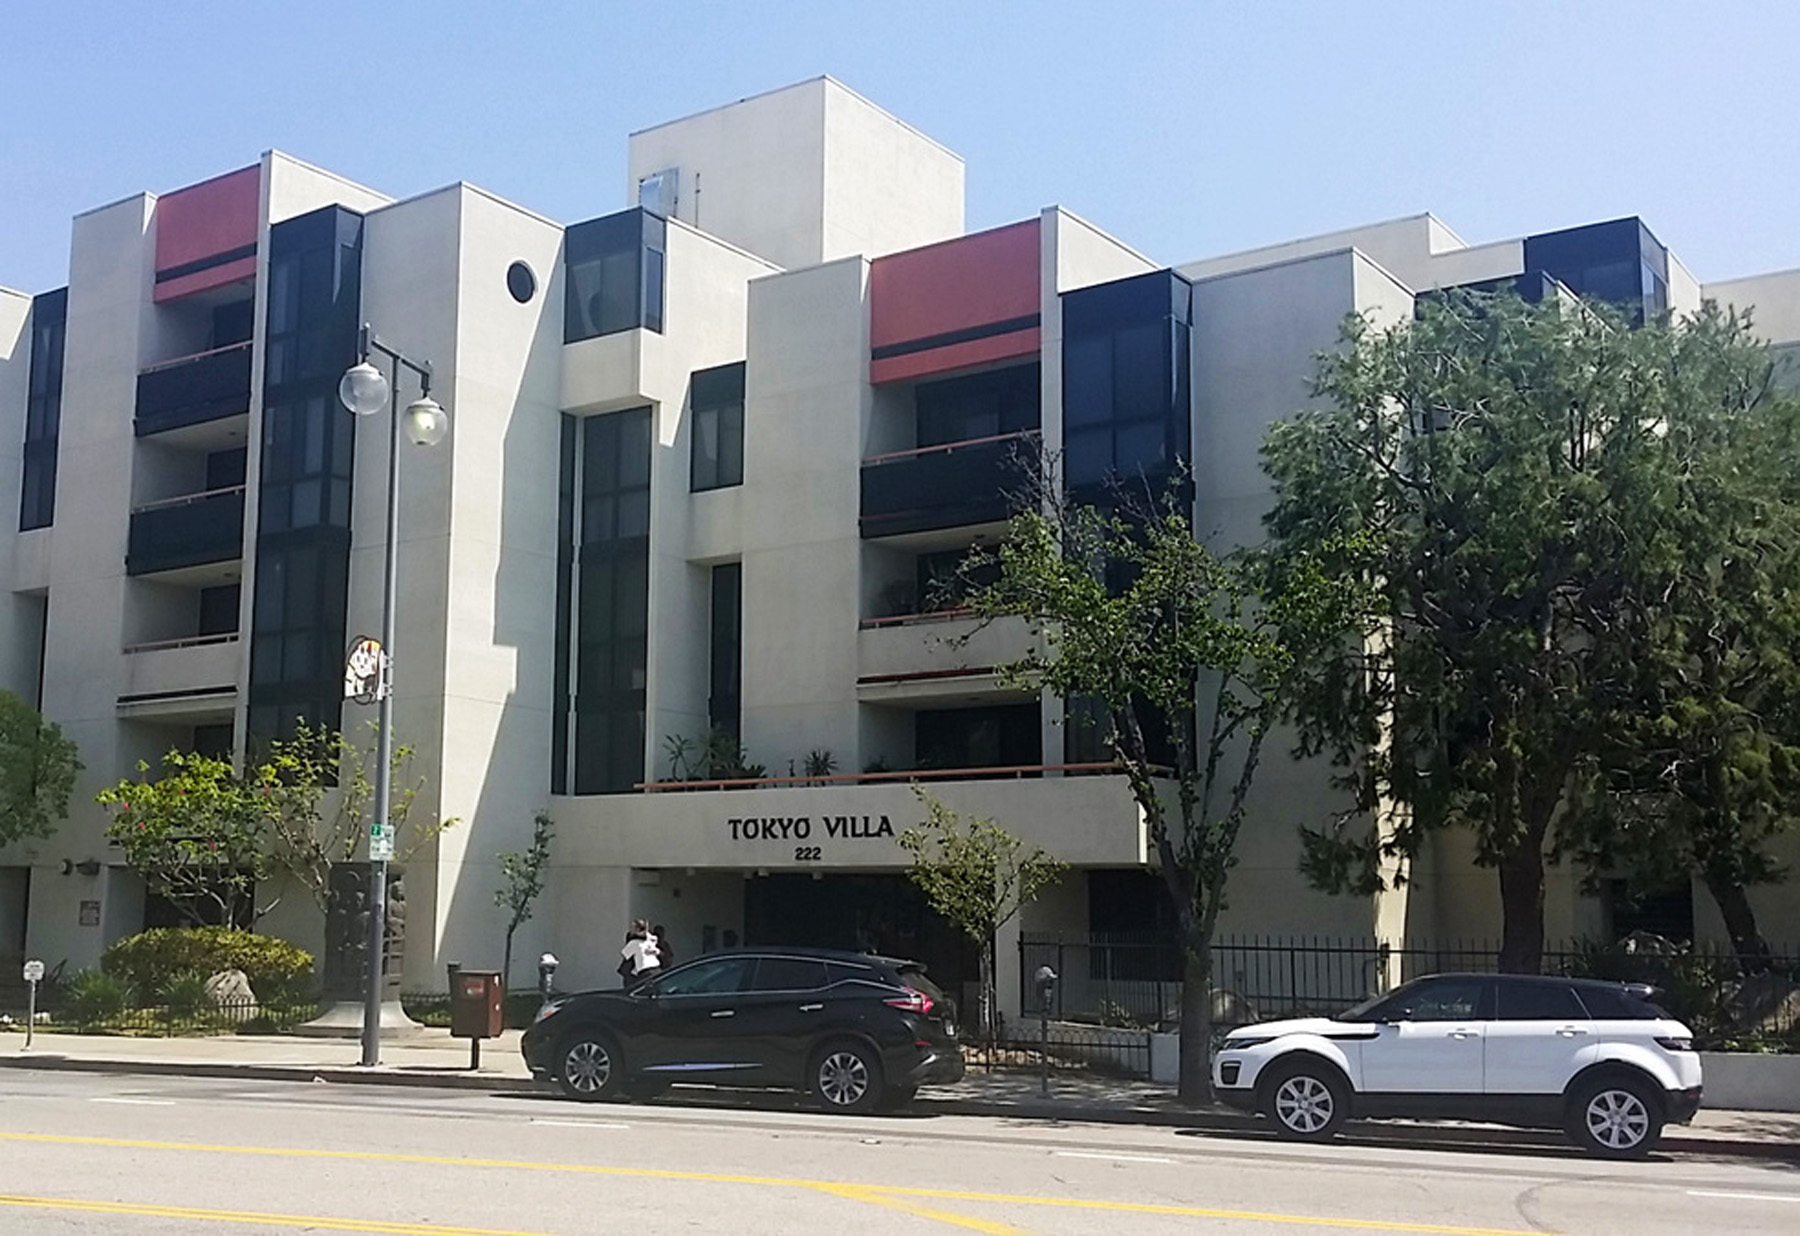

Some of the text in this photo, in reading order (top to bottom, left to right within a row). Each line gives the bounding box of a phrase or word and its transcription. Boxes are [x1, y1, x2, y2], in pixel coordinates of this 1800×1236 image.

[728, 815, 895, 840] TOKYO VILLA
[794, 847, 822, 861] 222
